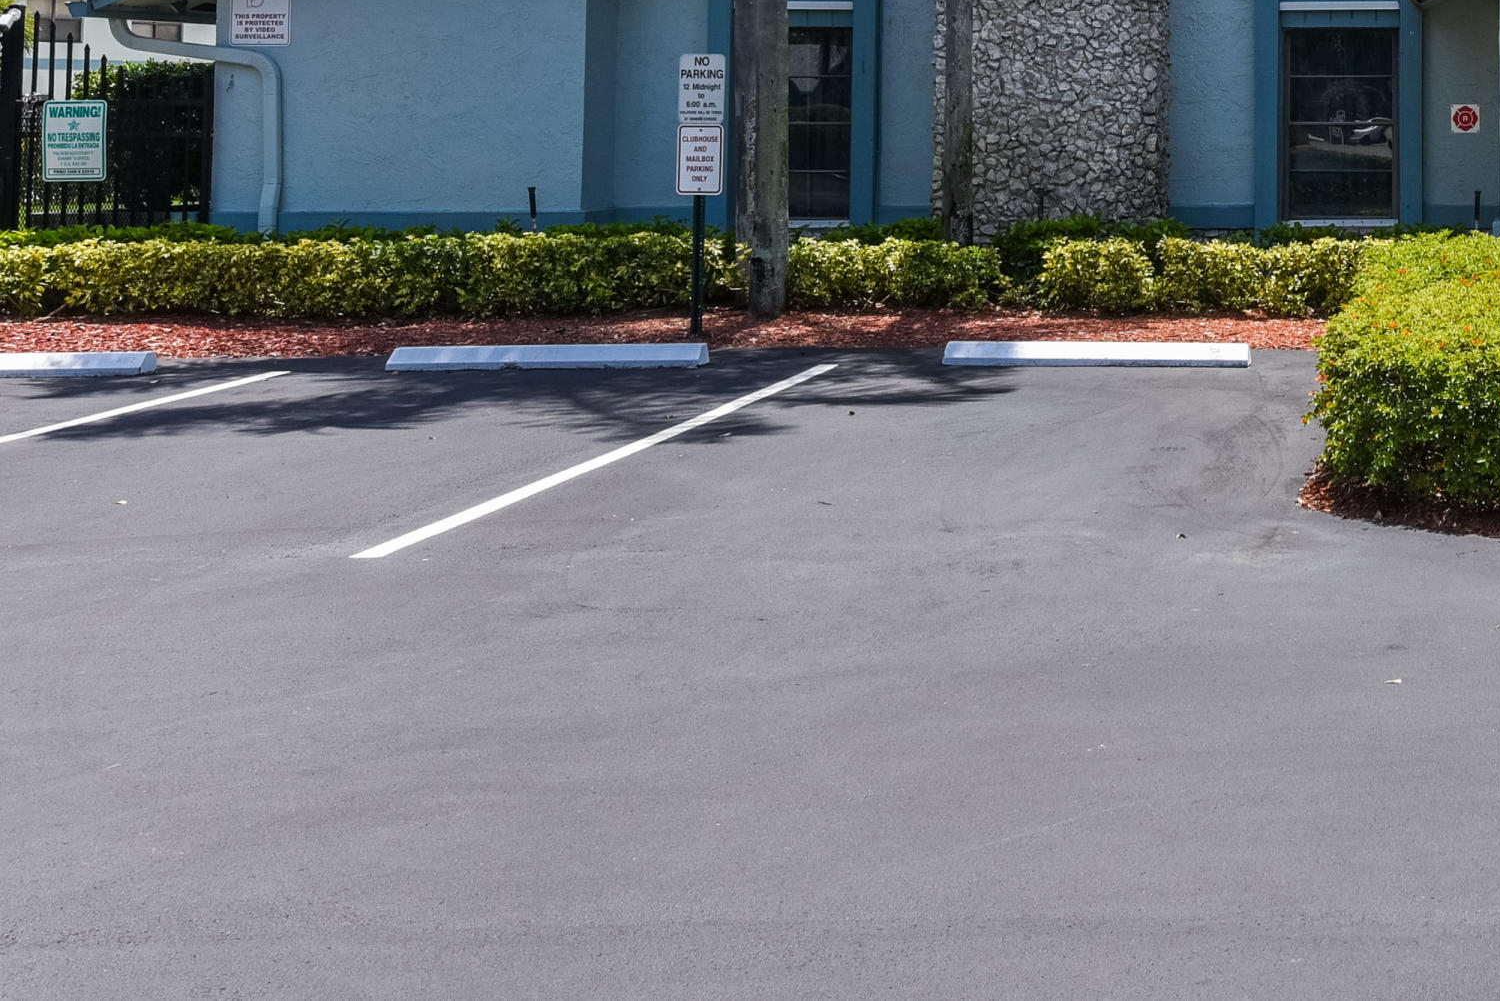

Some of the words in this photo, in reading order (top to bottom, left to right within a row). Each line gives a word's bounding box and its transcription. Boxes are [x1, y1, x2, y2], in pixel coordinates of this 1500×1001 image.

[694, 56, 710, 67] NO
[680, 69, 724, 79] PARKING
[683, 83, 690, 91] 12
[692, 83, 721, 92] Midnight
[49, 106, 101, 118] WARNING!
[47, 132, 57, 142] NO
[58, 132, 100, 142] TRESPASSING
